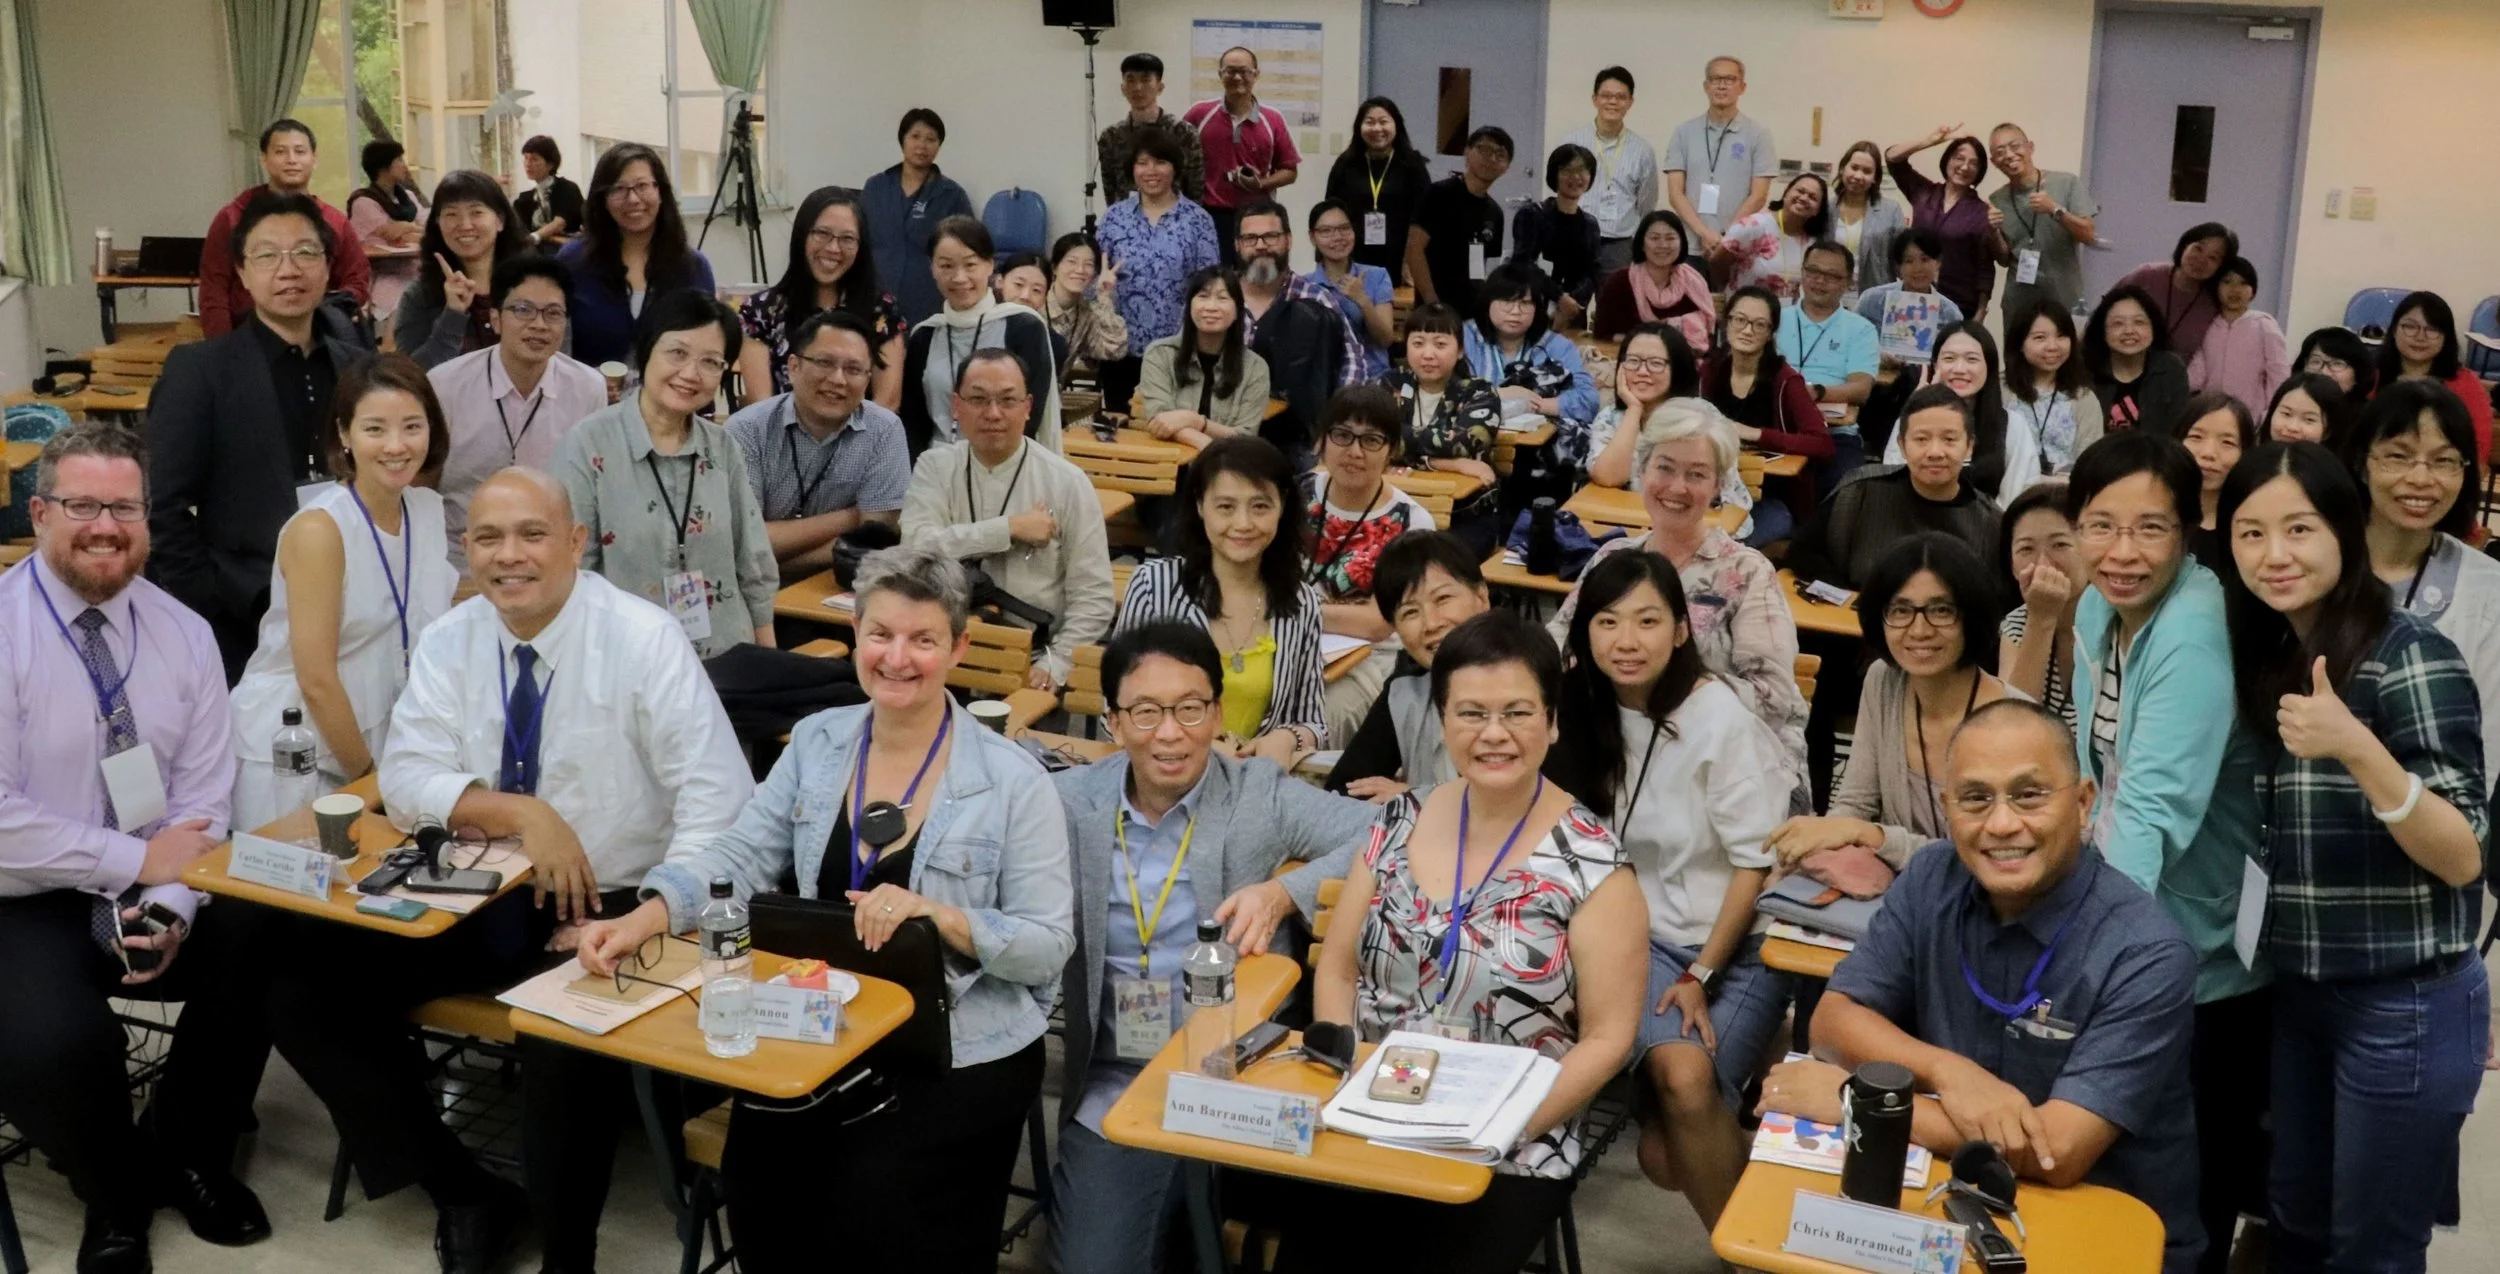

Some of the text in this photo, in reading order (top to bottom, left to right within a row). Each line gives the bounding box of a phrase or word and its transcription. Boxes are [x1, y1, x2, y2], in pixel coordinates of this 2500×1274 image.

[1170, 1099, 1272, 1127] Ann Barrameda
[1793, 1220, 1830, 1239] Chris
[1836, 1230, 1913, 1257] Barrameda
